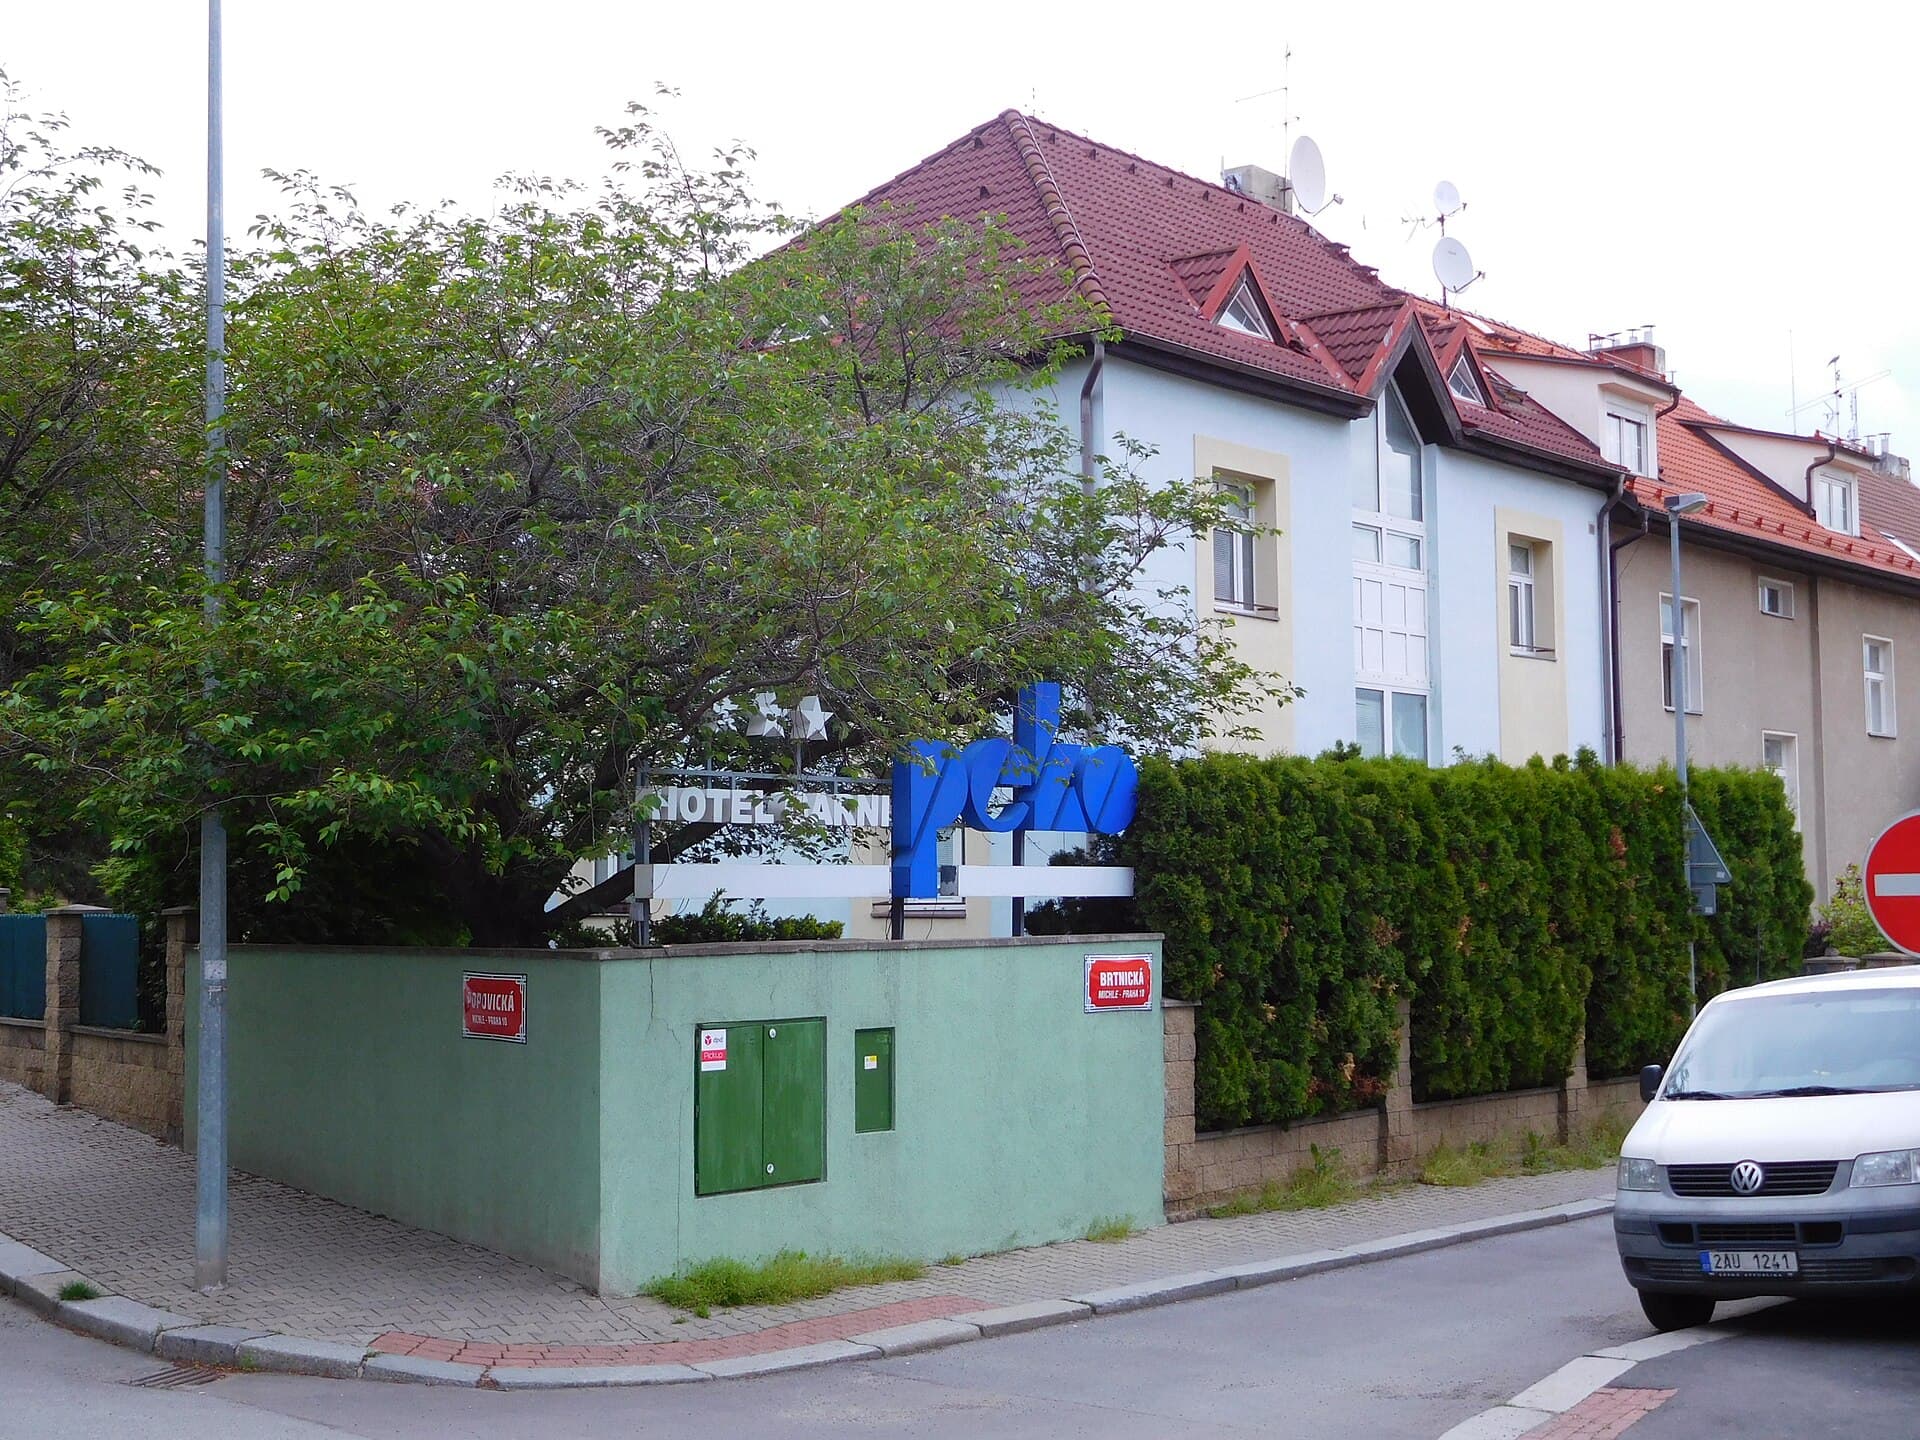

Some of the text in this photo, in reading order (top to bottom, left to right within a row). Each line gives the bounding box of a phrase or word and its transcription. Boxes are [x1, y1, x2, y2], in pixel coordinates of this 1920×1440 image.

[652, 786, 775, 824] HOTEL
[1100, 967, 1144, 987] BRTNICKÁ
[466, 990, 515, 1012] POPOVICKÁ
[1713, 1253, 1741, 1270] 2AU
[1752, 1253, 1791, 1270] 1241
